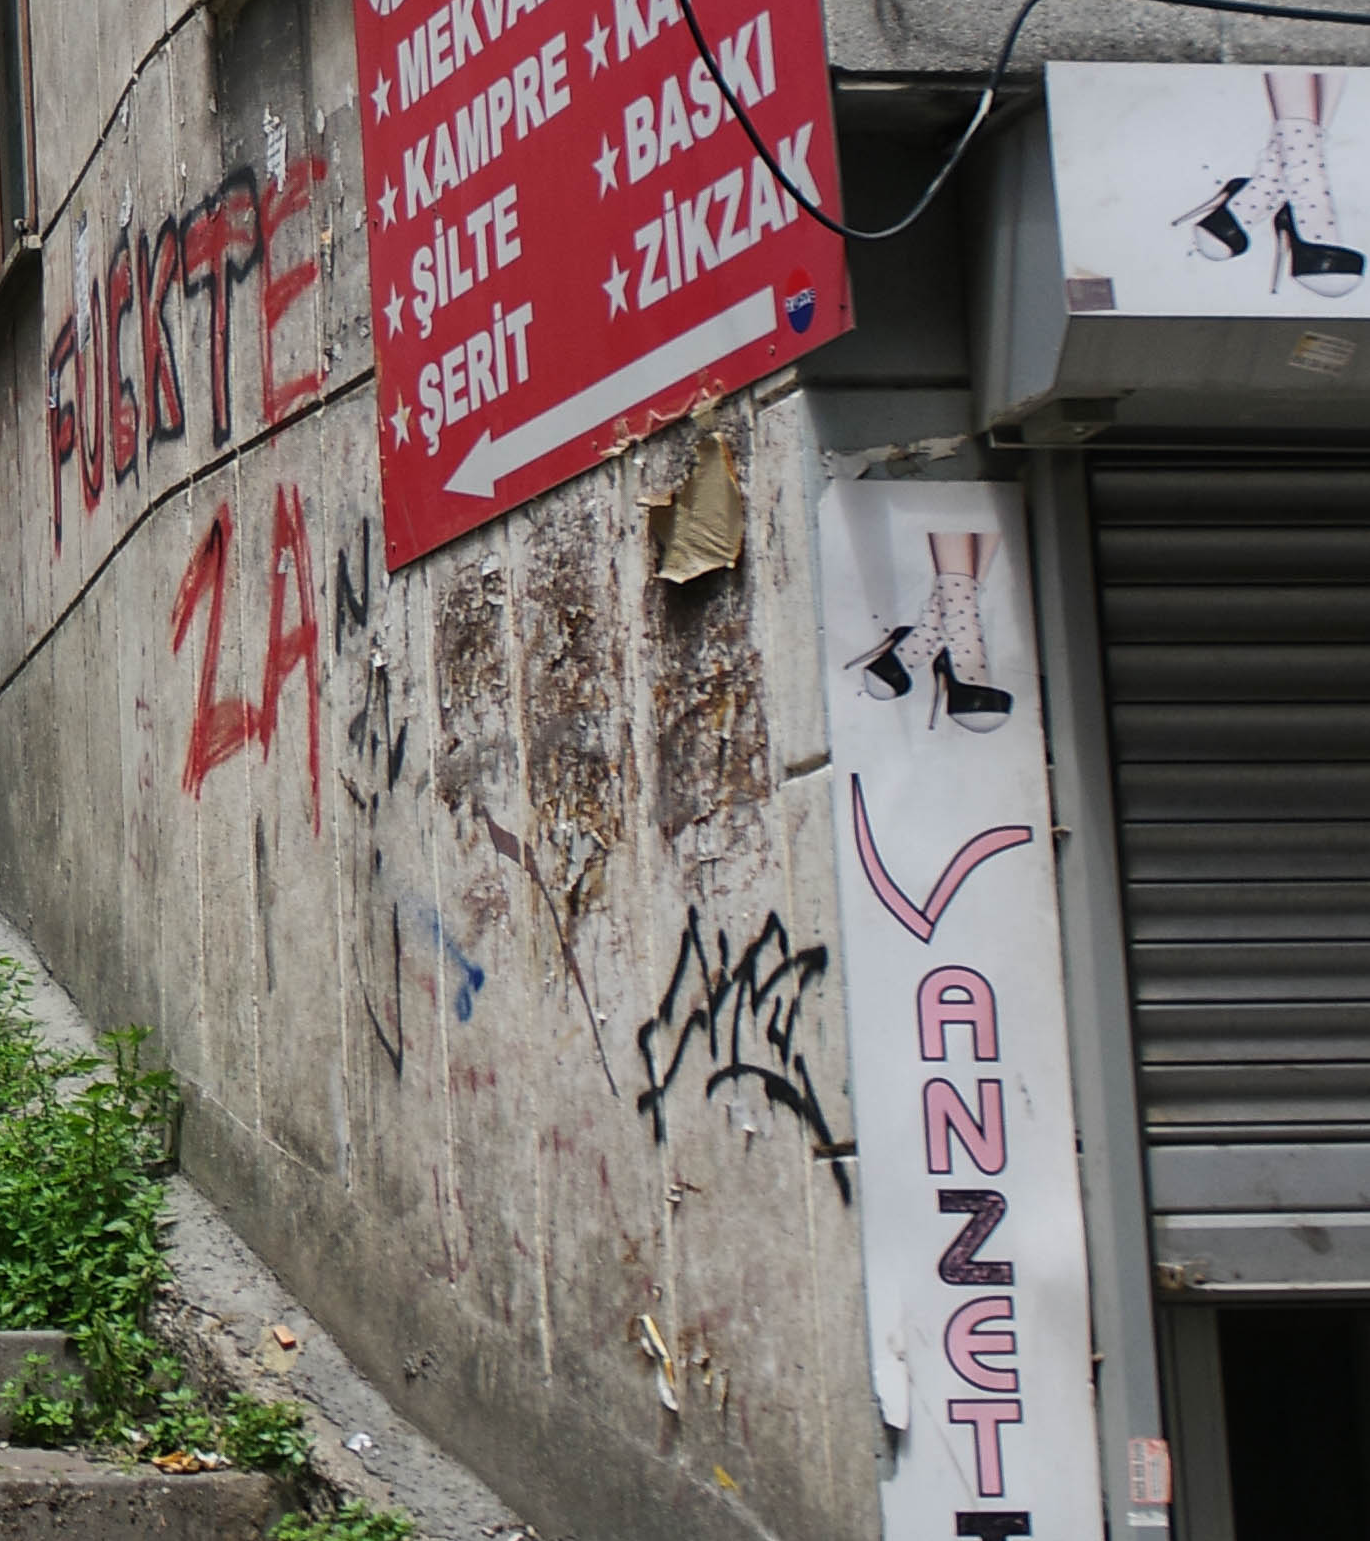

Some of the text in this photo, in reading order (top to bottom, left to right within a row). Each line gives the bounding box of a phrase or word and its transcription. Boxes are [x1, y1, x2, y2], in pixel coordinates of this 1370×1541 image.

[403, 32, 571, 220] KAMPRE
[624, 10, 776, 185] BASKI
[411, 184, 522, 339] ŞİLTE
[634, 122, 822, 310] ZİKZAK
[418, 302, 533, 457] ŞERİT
